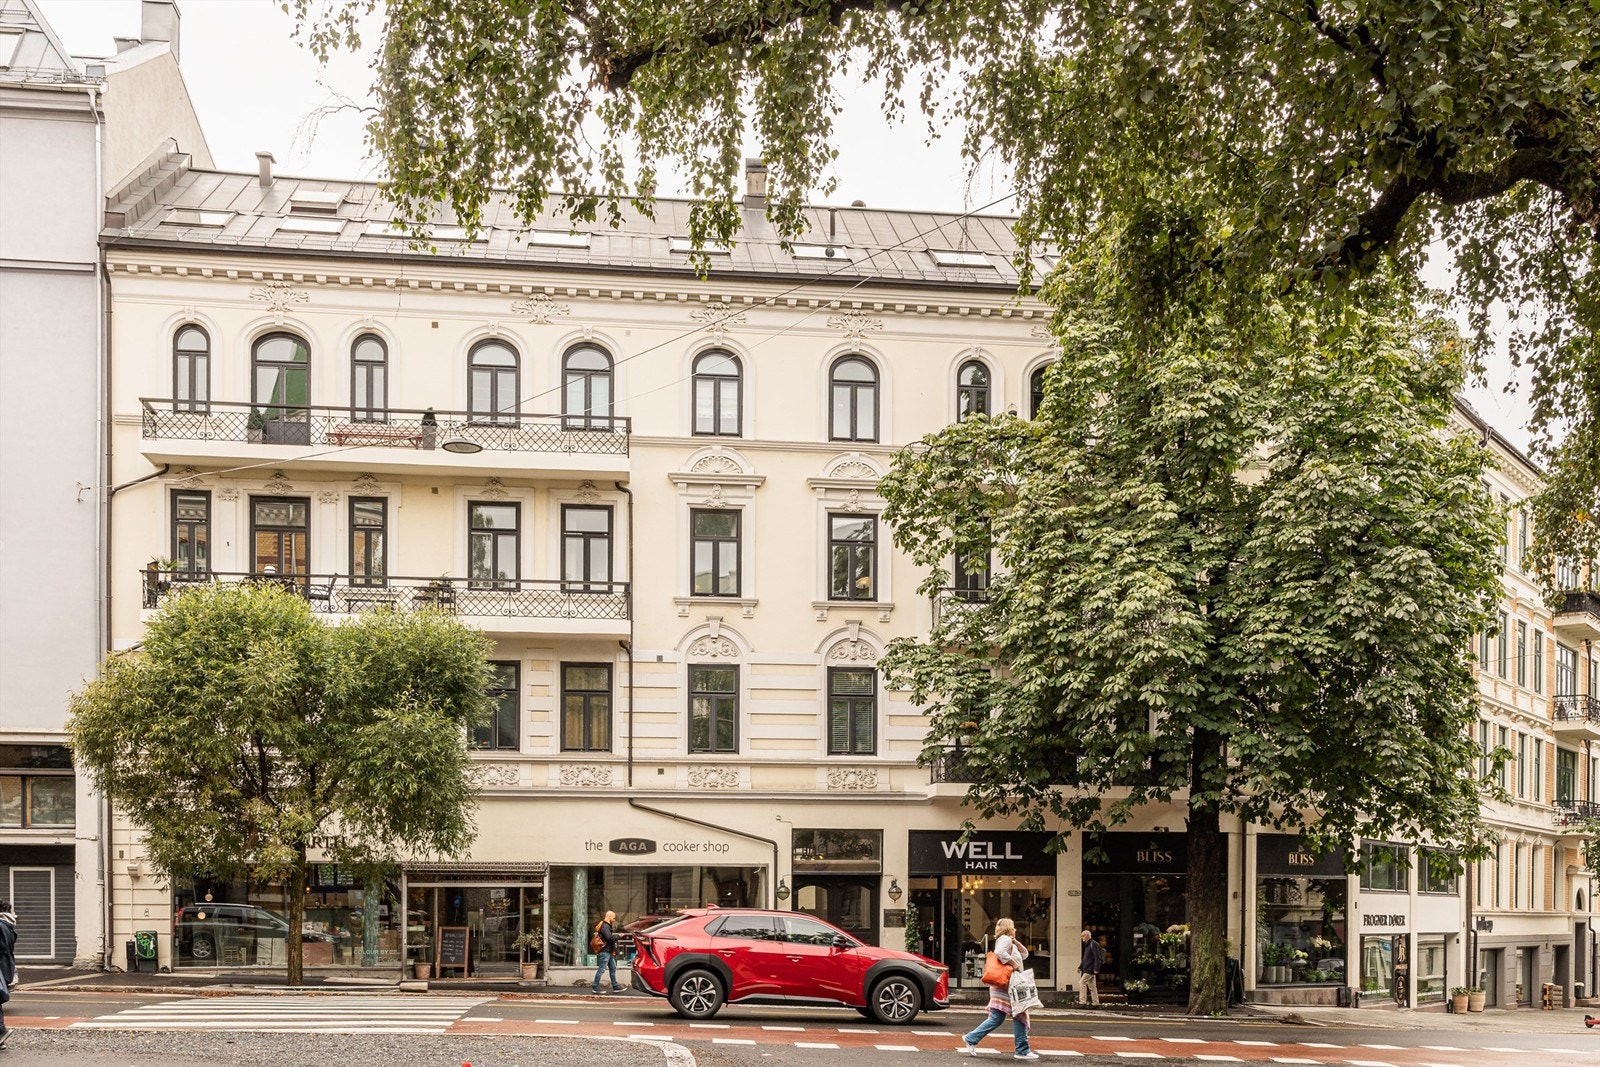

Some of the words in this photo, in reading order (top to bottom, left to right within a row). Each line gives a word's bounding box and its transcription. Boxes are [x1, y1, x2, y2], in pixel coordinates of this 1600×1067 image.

[585, 840, 604, 851] the
[619, 842, 648, 851] AGA
[663, 841, 700, 852] cooker
[703, 841, 730, 854] shop
[941, 841, 1023, 860] WELL
[1137, 851, 1172, 862] BLISS
[1288, 853, 1315, 865] BLISS
[965, 861, 998, 870] HAIR
[1363, 914, 1388, 927] FROGNER
